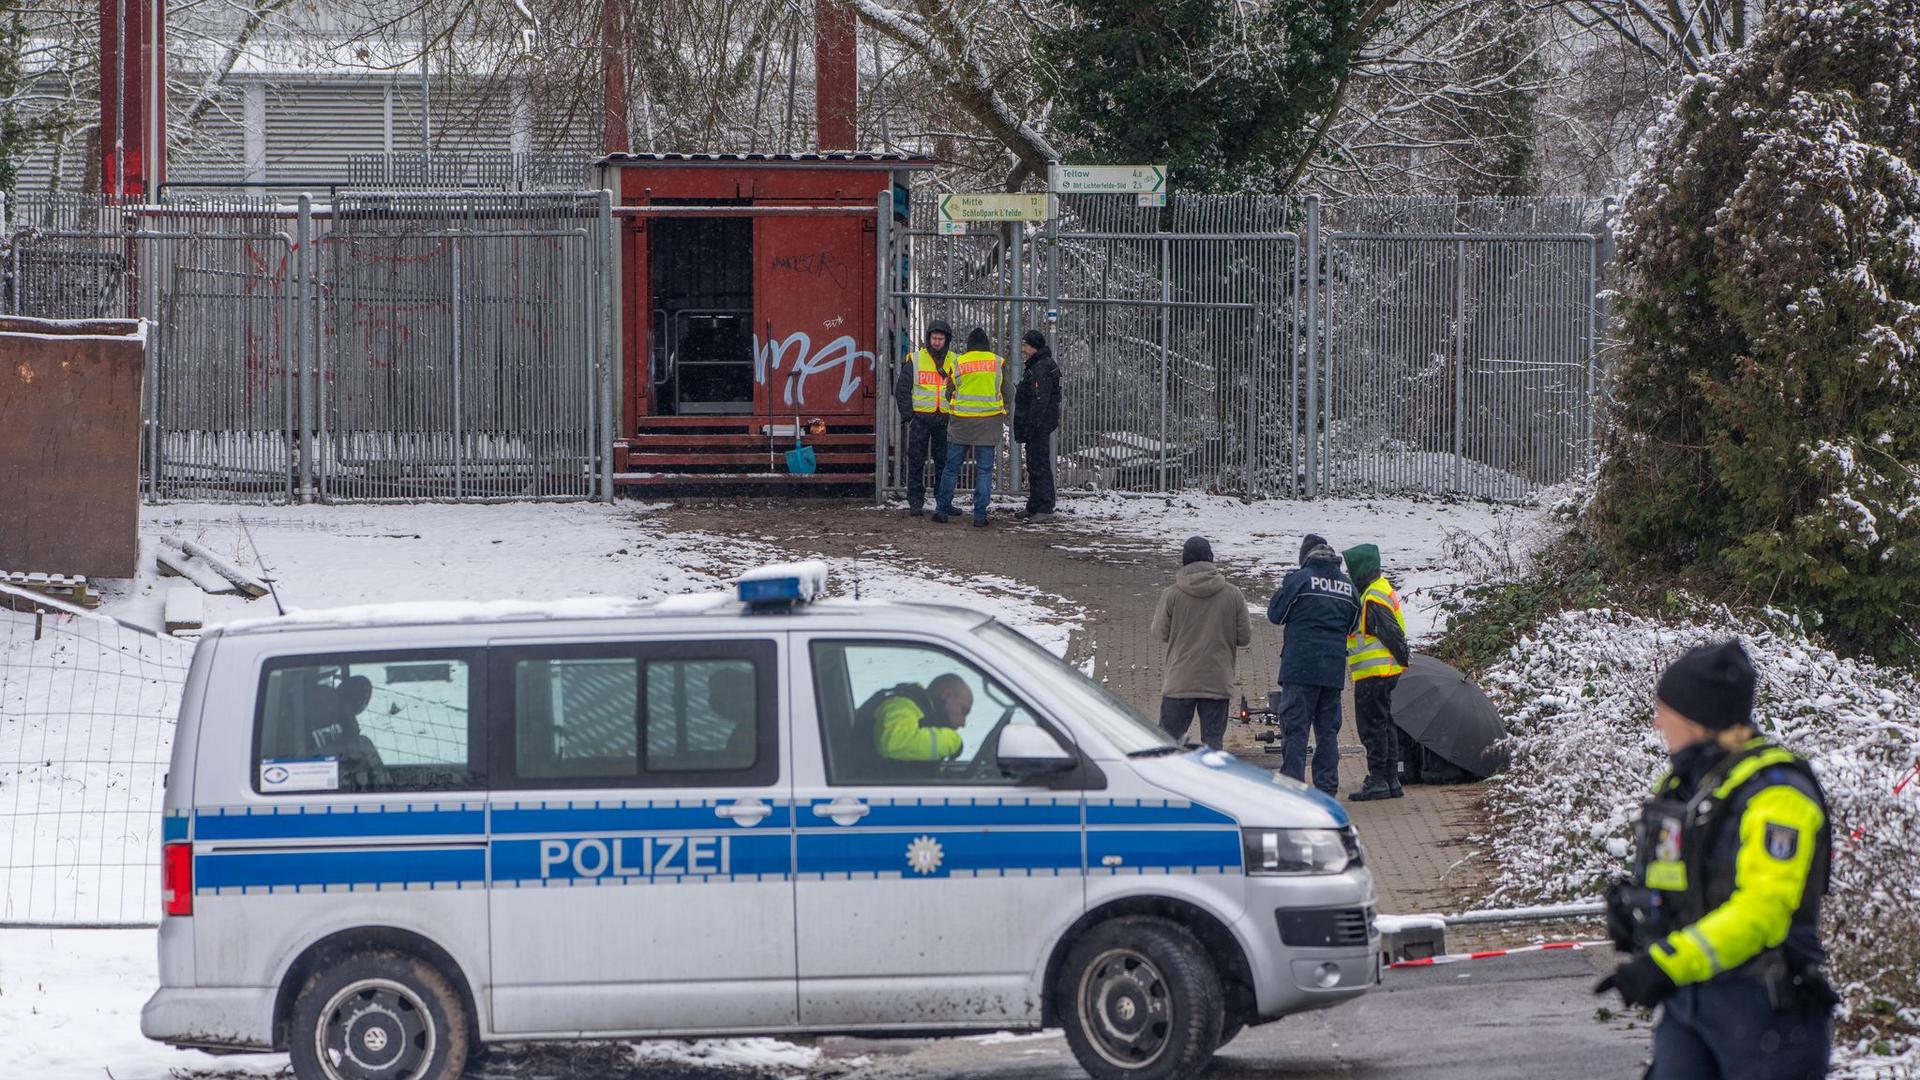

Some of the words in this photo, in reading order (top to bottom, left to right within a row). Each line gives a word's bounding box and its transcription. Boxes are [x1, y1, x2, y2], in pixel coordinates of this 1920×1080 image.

[1063, 170, 1090, 178] Teltow
[1083, 181, 1127, 190] Lichterfelde-Süd
[962, 198, 983, 206] Mitte
[962, 208, 998, 218] Schloßpark
[959, 360, 995, 376] POLIZEI
[1310, 576, 1352, 597] POLIZEI
[540, 836, 731, 879] POLIZEI
